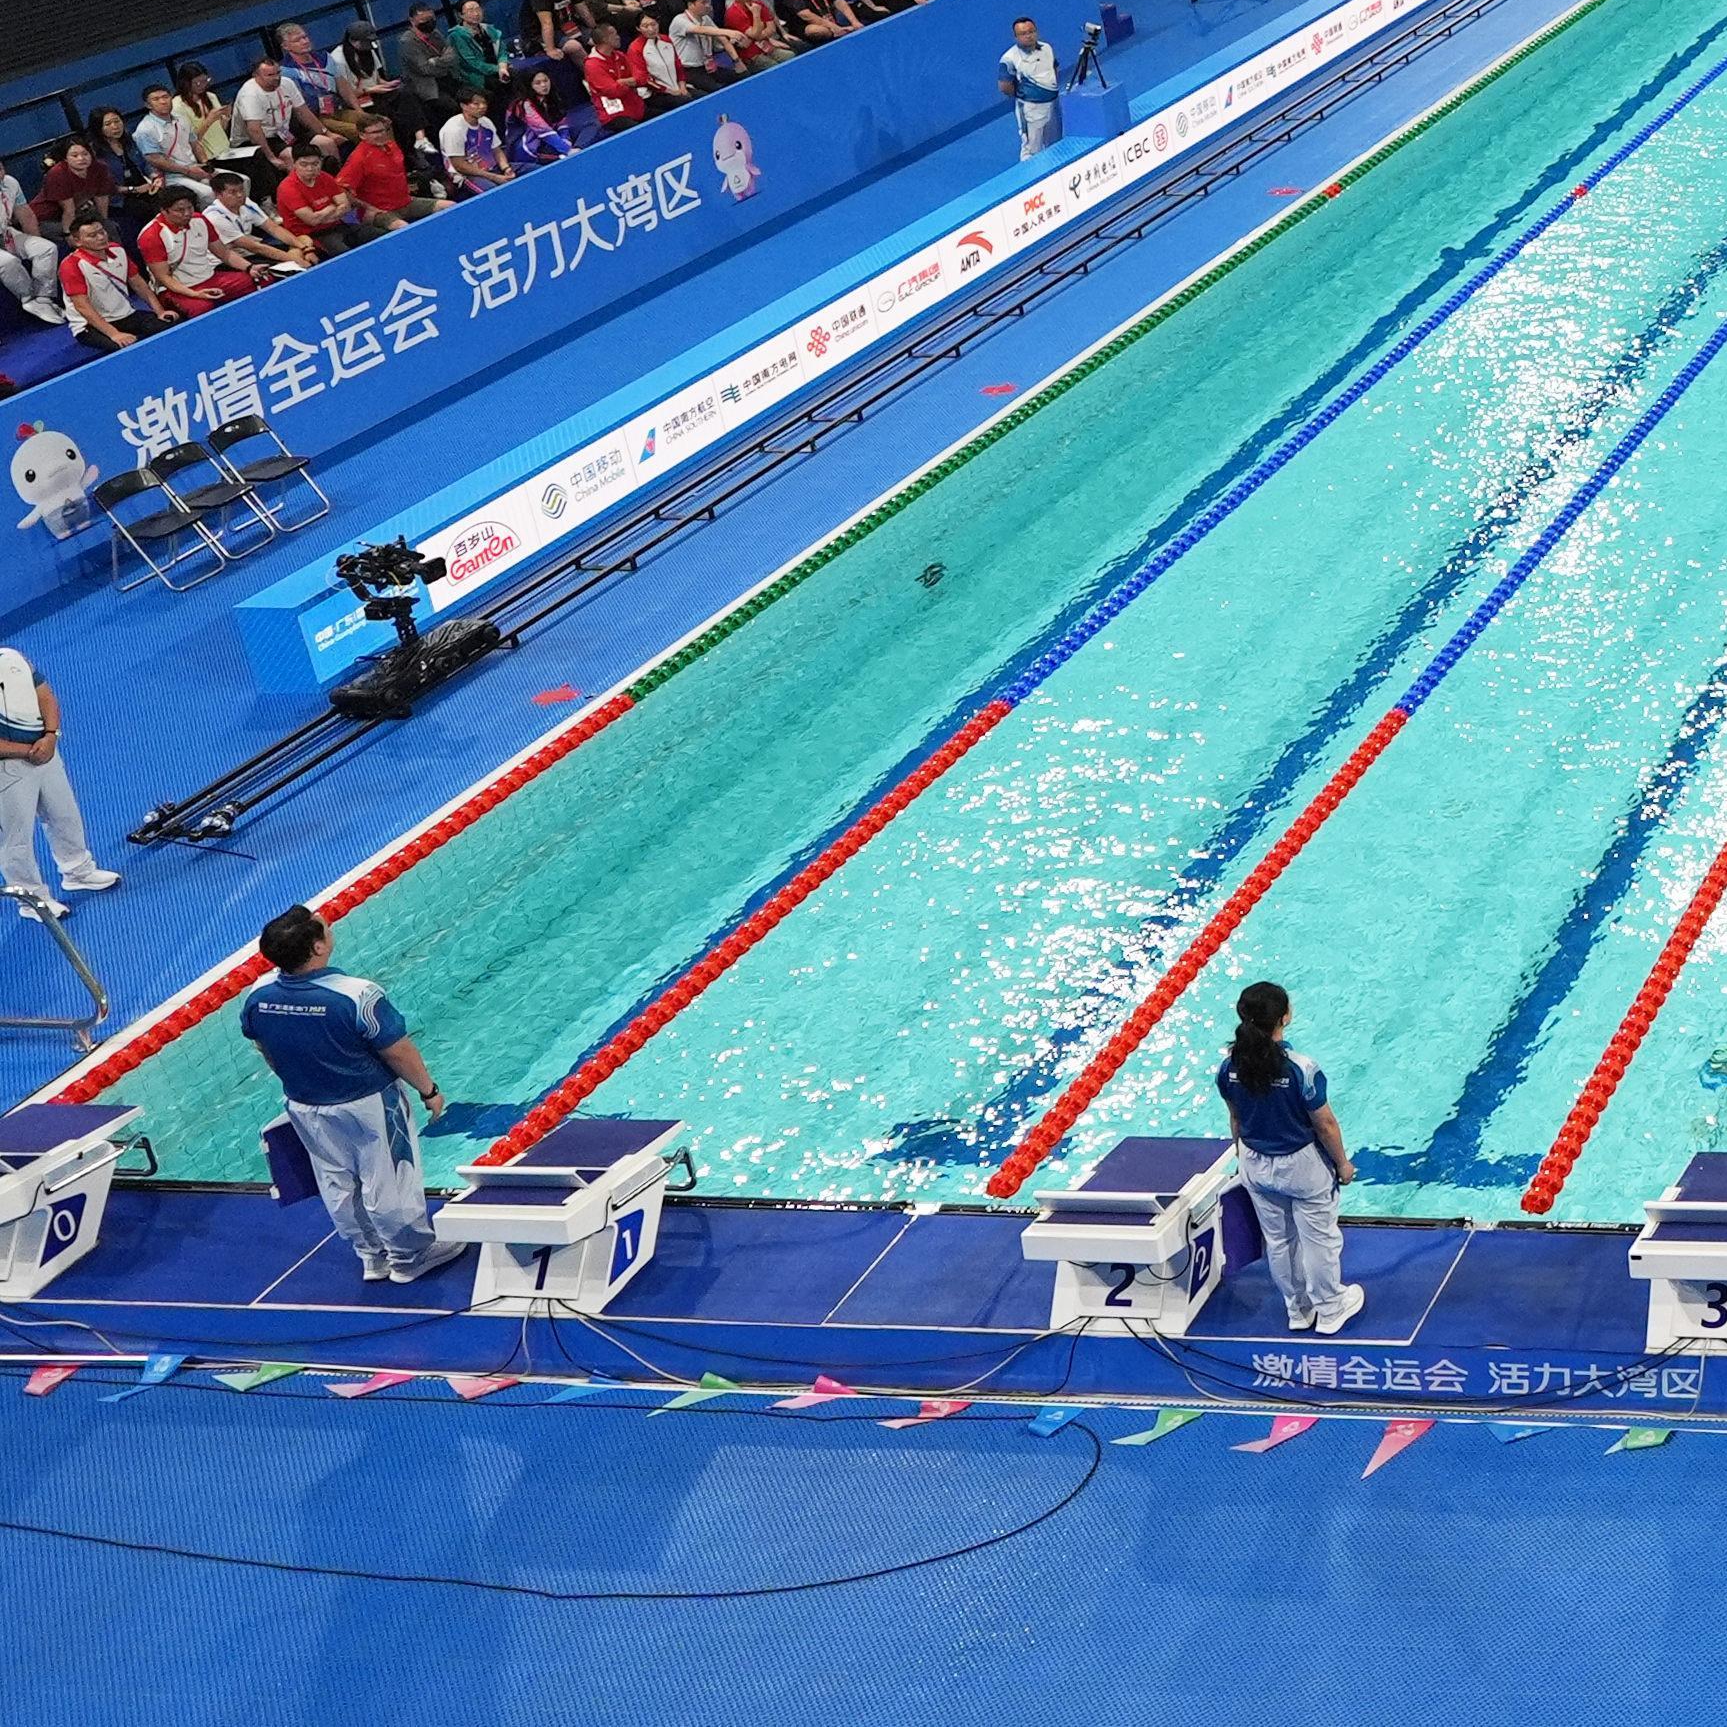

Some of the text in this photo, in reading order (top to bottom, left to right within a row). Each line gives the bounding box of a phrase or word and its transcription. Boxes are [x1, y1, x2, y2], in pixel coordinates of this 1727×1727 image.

[1122, 137, 1151, 167] ICBC
[1024, 191, 1046, 217] PICC
[458, 150, 704, 319] 活力大湾区
[960, 249, 982, 275] ANTA
[570, 448, 624, 488] 中国移动
[574, 483, 600, 503] China
[453, 525, 495, 558] 百岁山
[52, 1207, 74, 1244] 0
[622, 1227, 639, 1261] 1
[529, 1247, 552, 1291] 1
[1193, 1245, 1212, 1287] 2
[1103, 1262, 1137, 1309] 2
[1251, 1352, 1702, 1400] 激情全运会 活力大湾区
